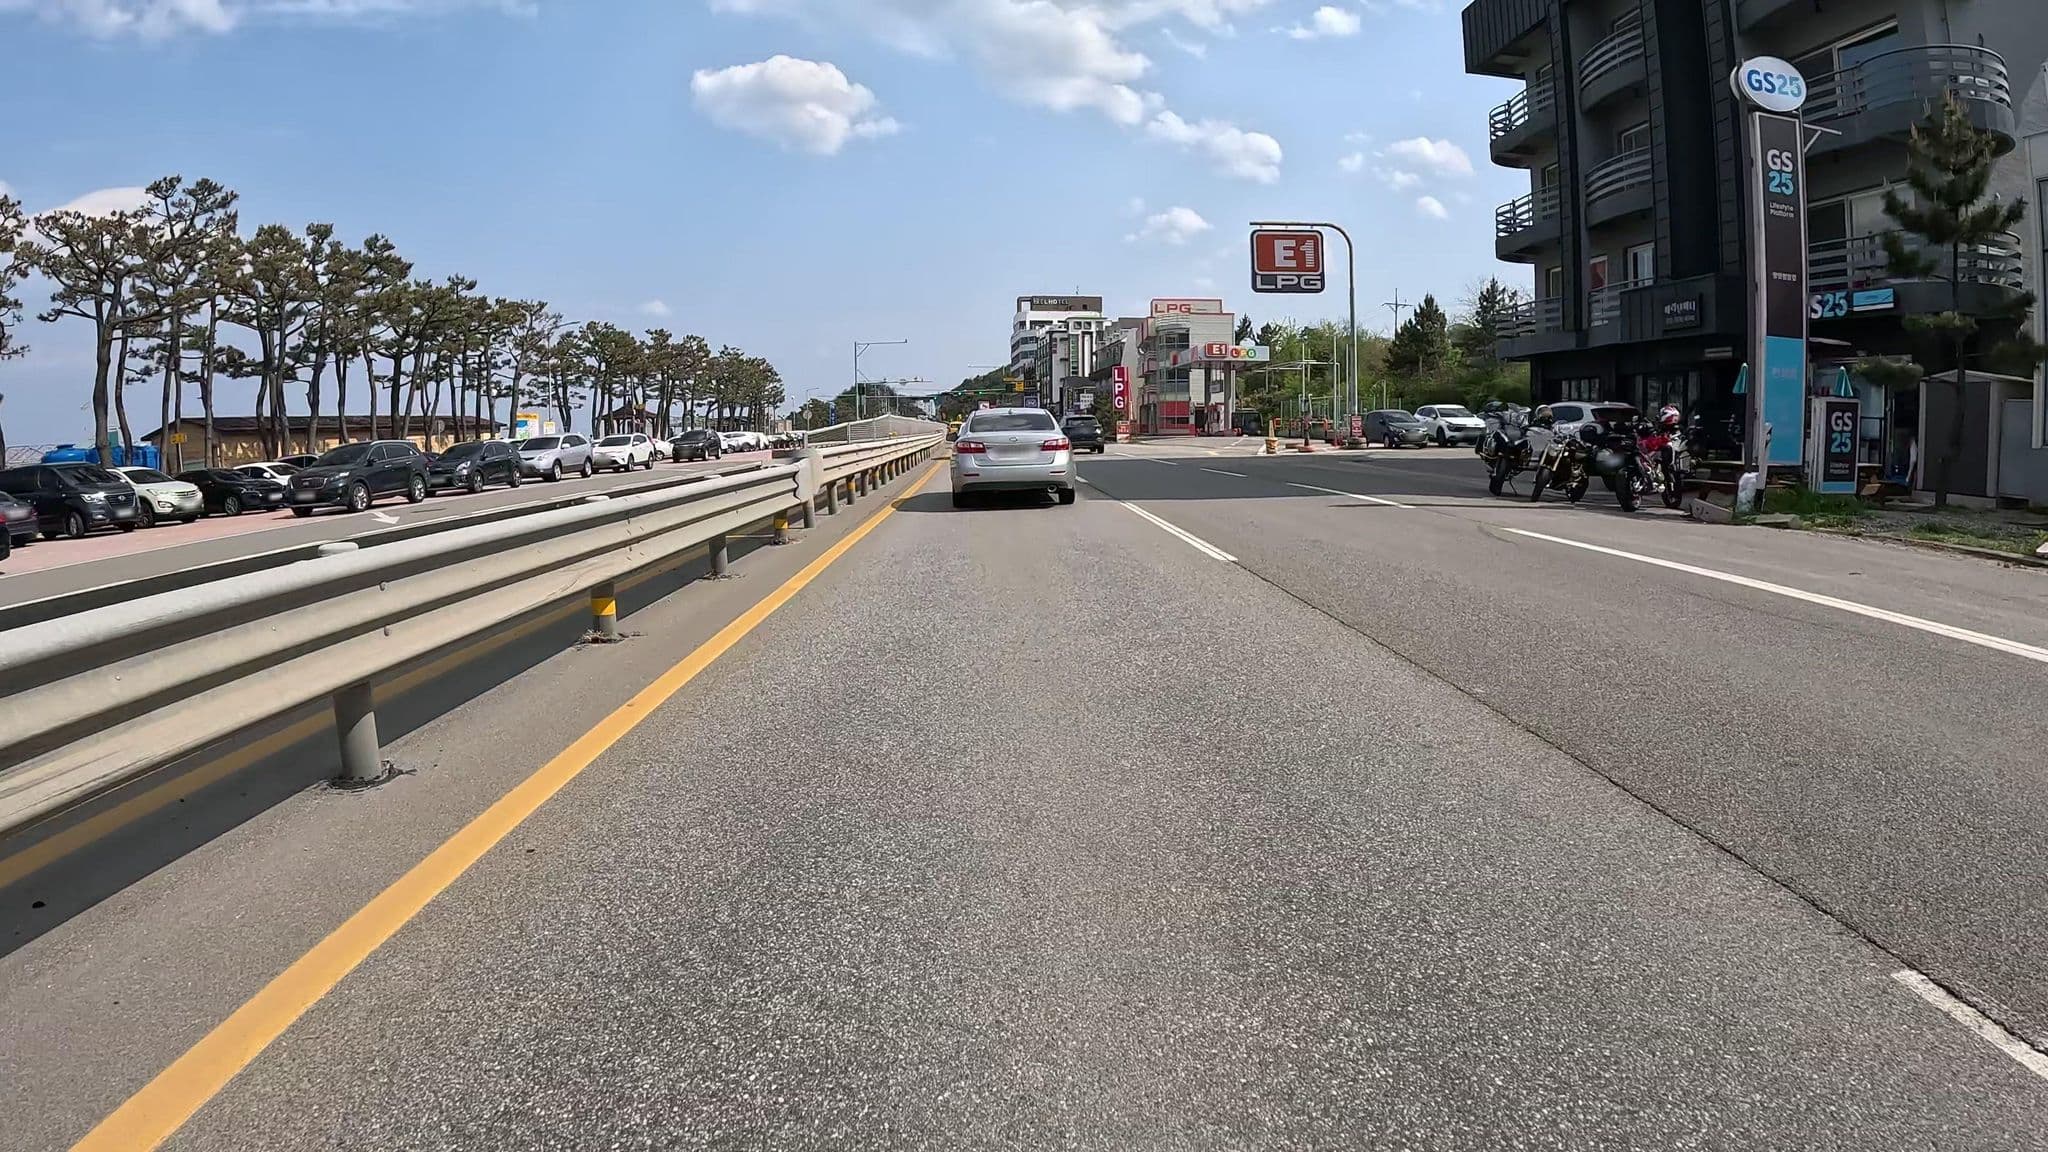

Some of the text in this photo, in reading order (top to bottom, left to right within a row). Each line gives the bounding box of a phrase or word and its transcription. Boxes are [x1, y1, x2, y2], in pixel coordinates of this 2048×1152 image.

[1747, 69, 1802, 98] GS25
[1767, 149, 1793, 172] GS
[1769, 172, 1794, 195] 25
[1274, 240, 1315, 267] E1
[1256, 275, 1321, 289] LPG
[1154, 303, 1191, 314] LPG
[1212, 344, 1226, 355] E1
[1115, 369, 1124, 409] LPG
[1831, 411, 1853, 432] GS
[1831, 432, 1852, 453] 25
